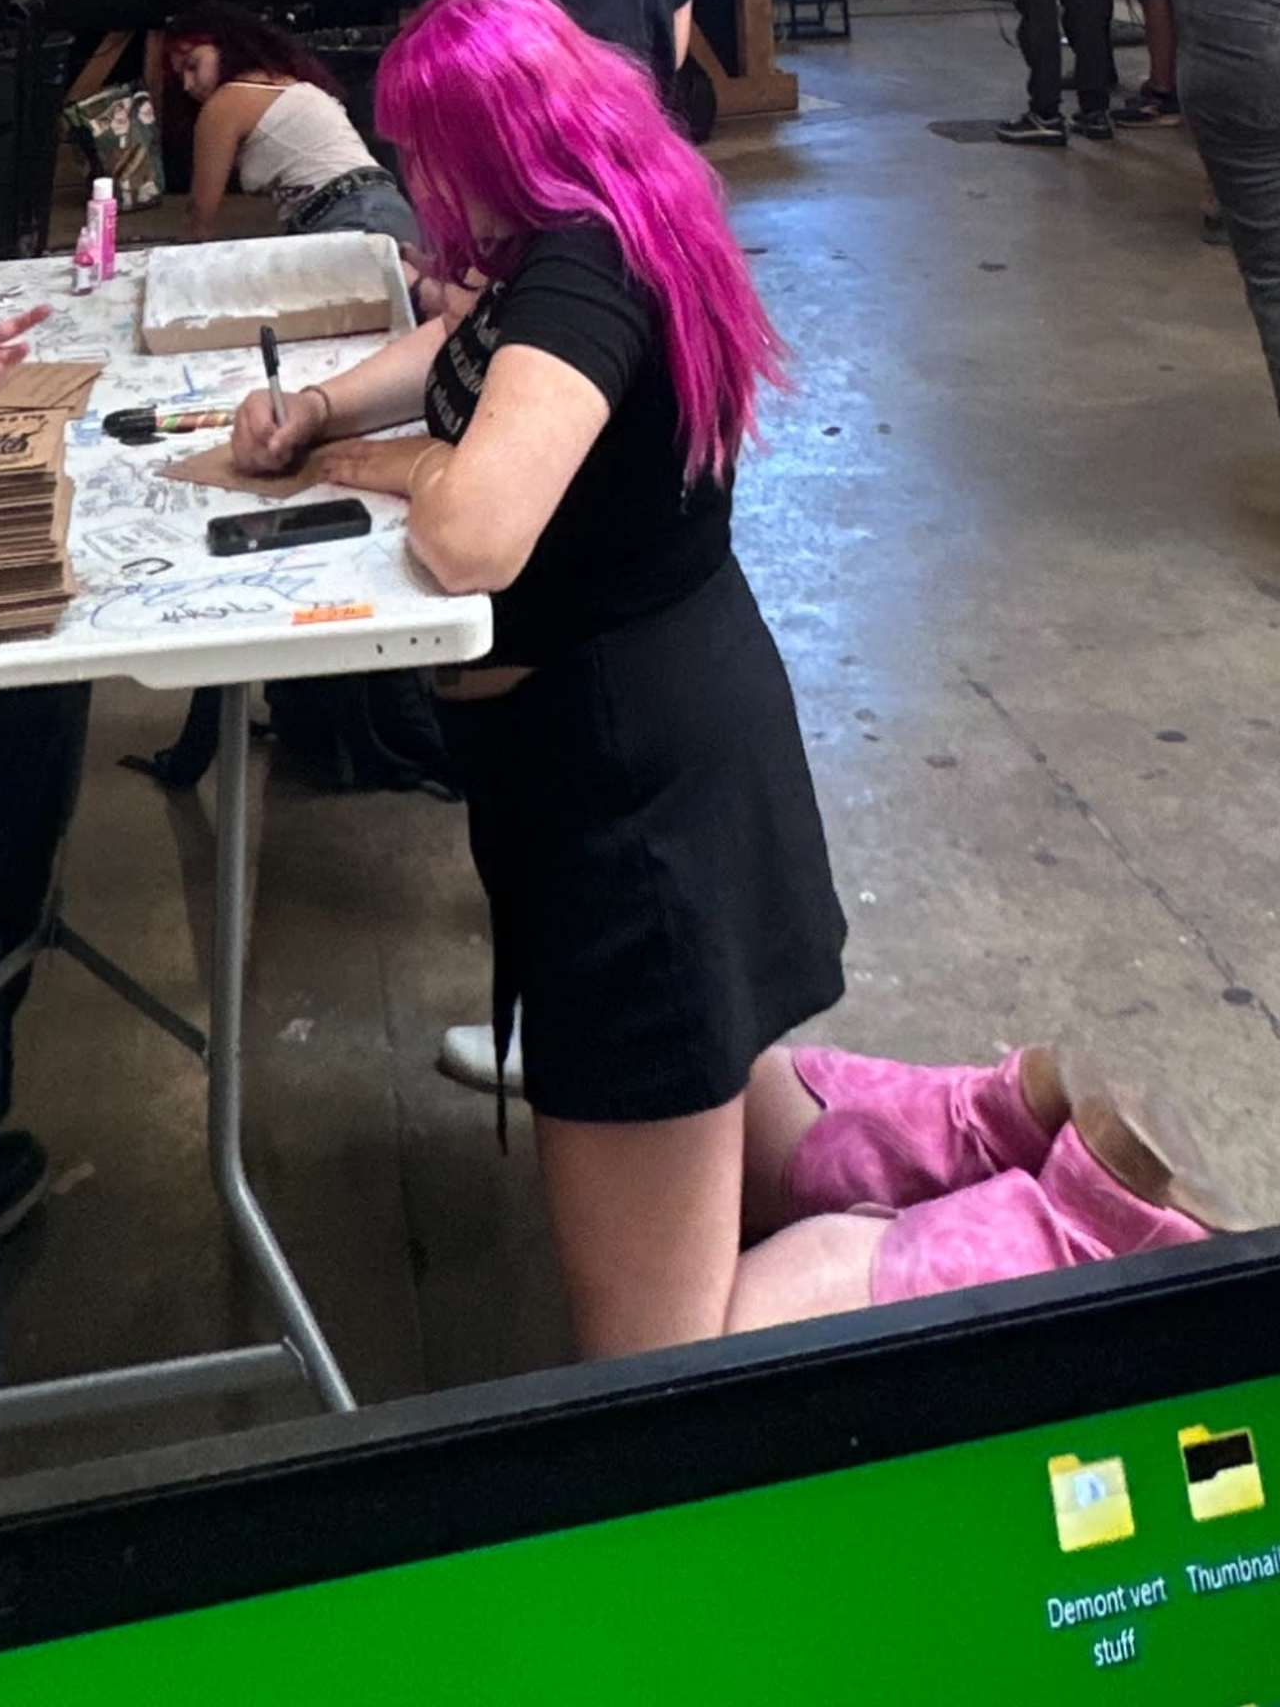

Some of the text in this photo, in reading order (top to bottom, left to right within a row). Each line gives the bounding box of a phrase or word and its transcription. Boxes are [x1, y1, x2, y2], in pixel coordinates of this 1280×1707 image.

[1047, 1575, 1167, 1629] Demont vert
[1093, 1627, 1137, 1667] stuff
